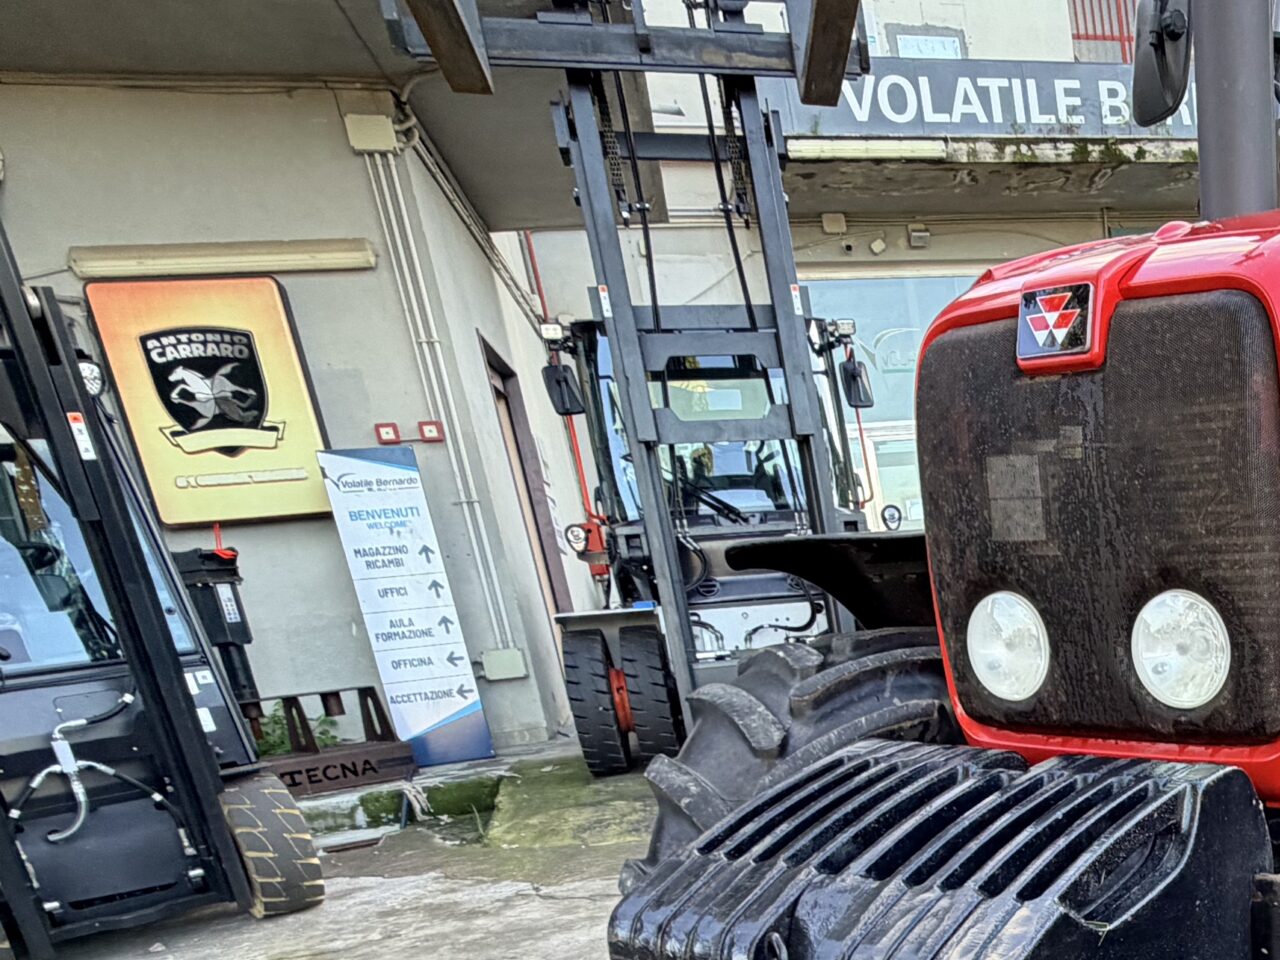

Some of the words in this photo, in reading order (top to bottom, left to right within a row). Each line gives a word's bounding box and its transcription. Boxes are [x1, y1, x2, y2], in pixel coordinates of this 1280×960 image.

[841, 75, 1086, 124] VOLATILE
[146, 332, 248, 349] ANTONIO
[150, 342, 249, 364] CARRARO
[341, 478, 374, 489] Volatile
[376, 476, 418, 487] Bernardo
[348, 506, 421, 522] BENVENUTI
[366, 520, 409, 531] WELCOME
[353, 544, 409, 559] MAGAZZINO
[365, 557, 405, 571] RICAMBI
[377, 586, 409, 599] UFFICI
[389, 617, 415, 629] AULA
[374, 627, 435, 643] FORMAZIONE
[391, 656, 434, 670] OFFICINA
[389, 688, 456, 705] ACCETTAZIONE
[280, 759, 379, 788] TECNA
